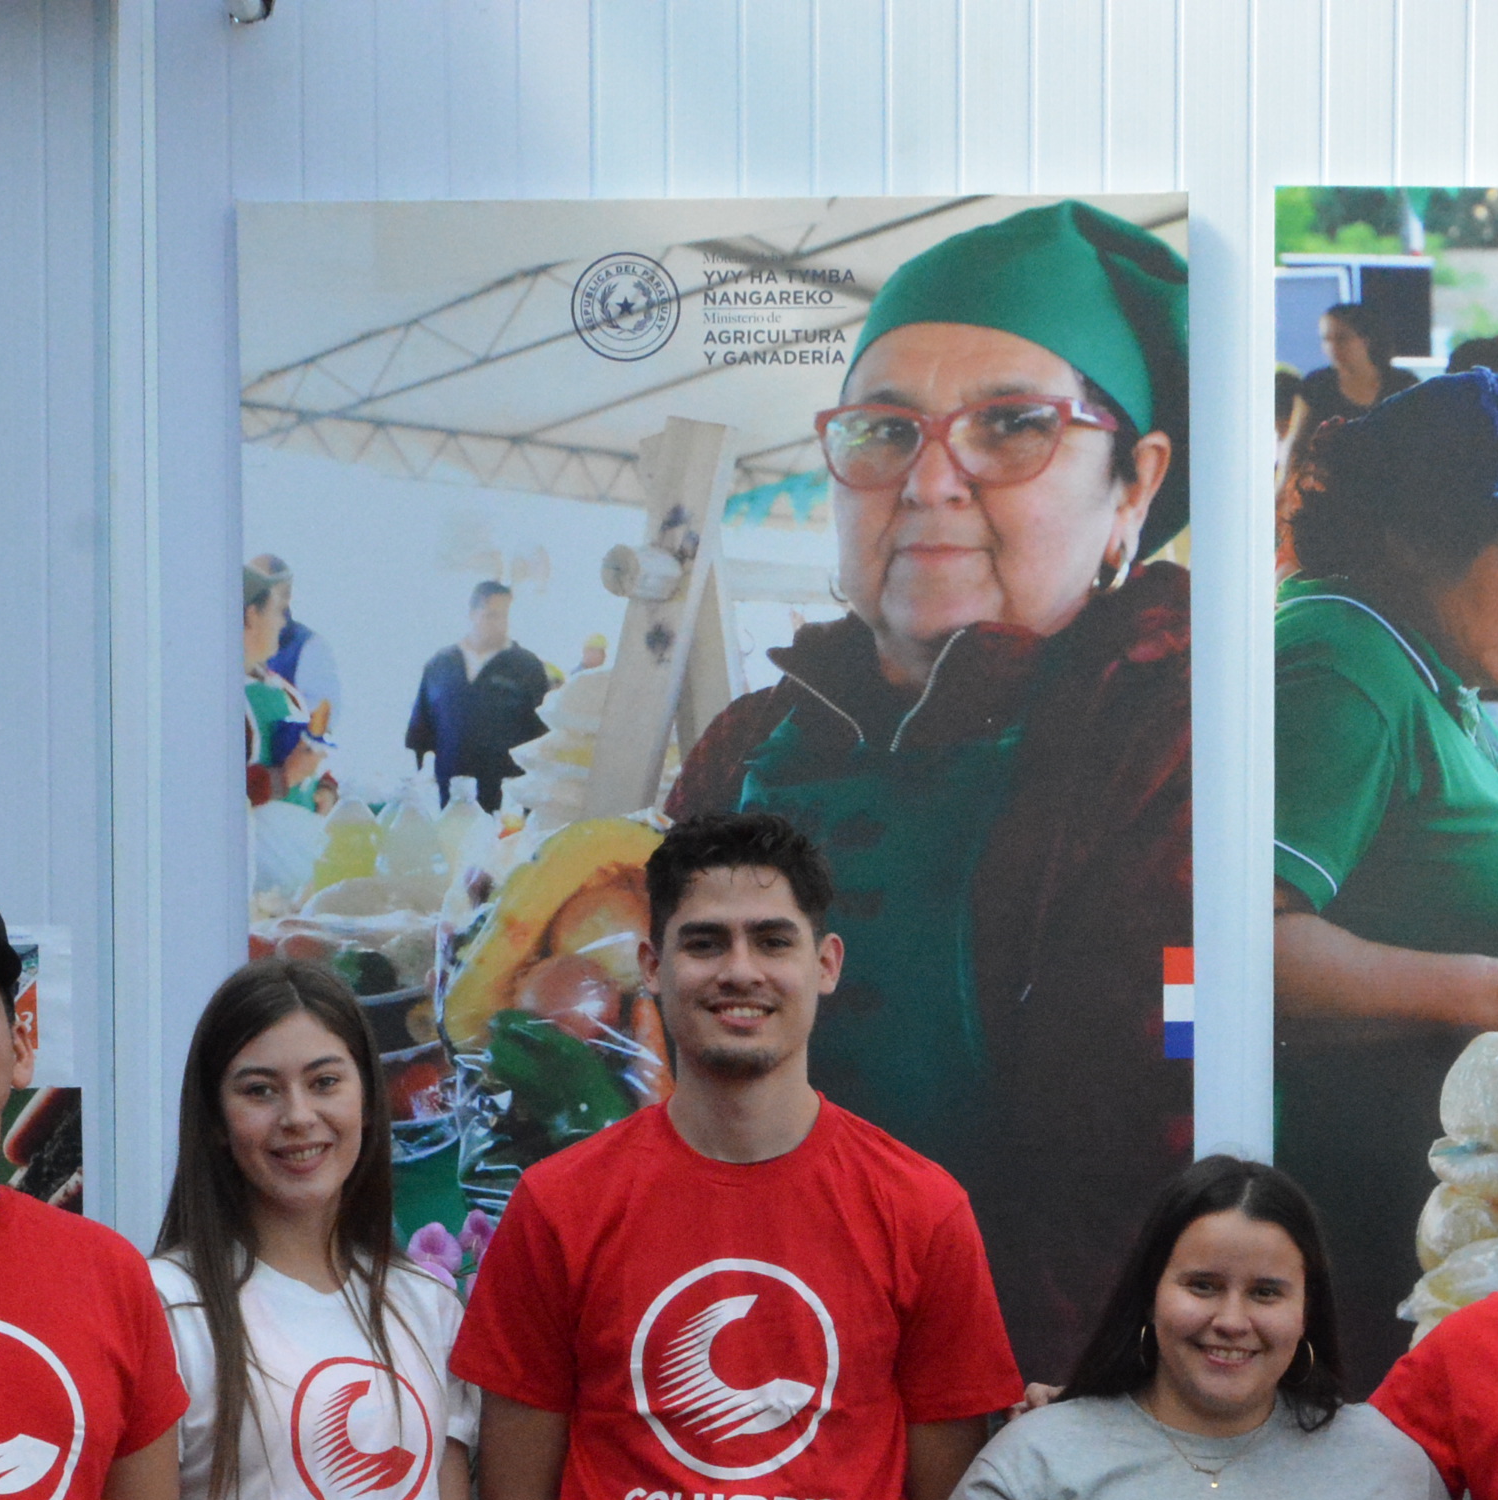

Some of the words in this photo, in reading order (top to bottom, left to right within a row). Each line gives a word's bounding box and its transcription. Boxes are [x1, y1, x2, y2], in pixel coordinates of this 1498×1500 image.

[615, 264, 638, 275] DEL
[703, 269, 744, 285] YVY
[750, 269, 778, 285] HA
[787, 268, 856, 285] TYMBA
[702, 312, 765, 325] Ministerio
[766, 312, 782, 325] de
[703, 329, 847, 345] AGRICULTURA
[703, 350, 717, 366] Y
[723, 346, 846, 366] GANADERÍA
